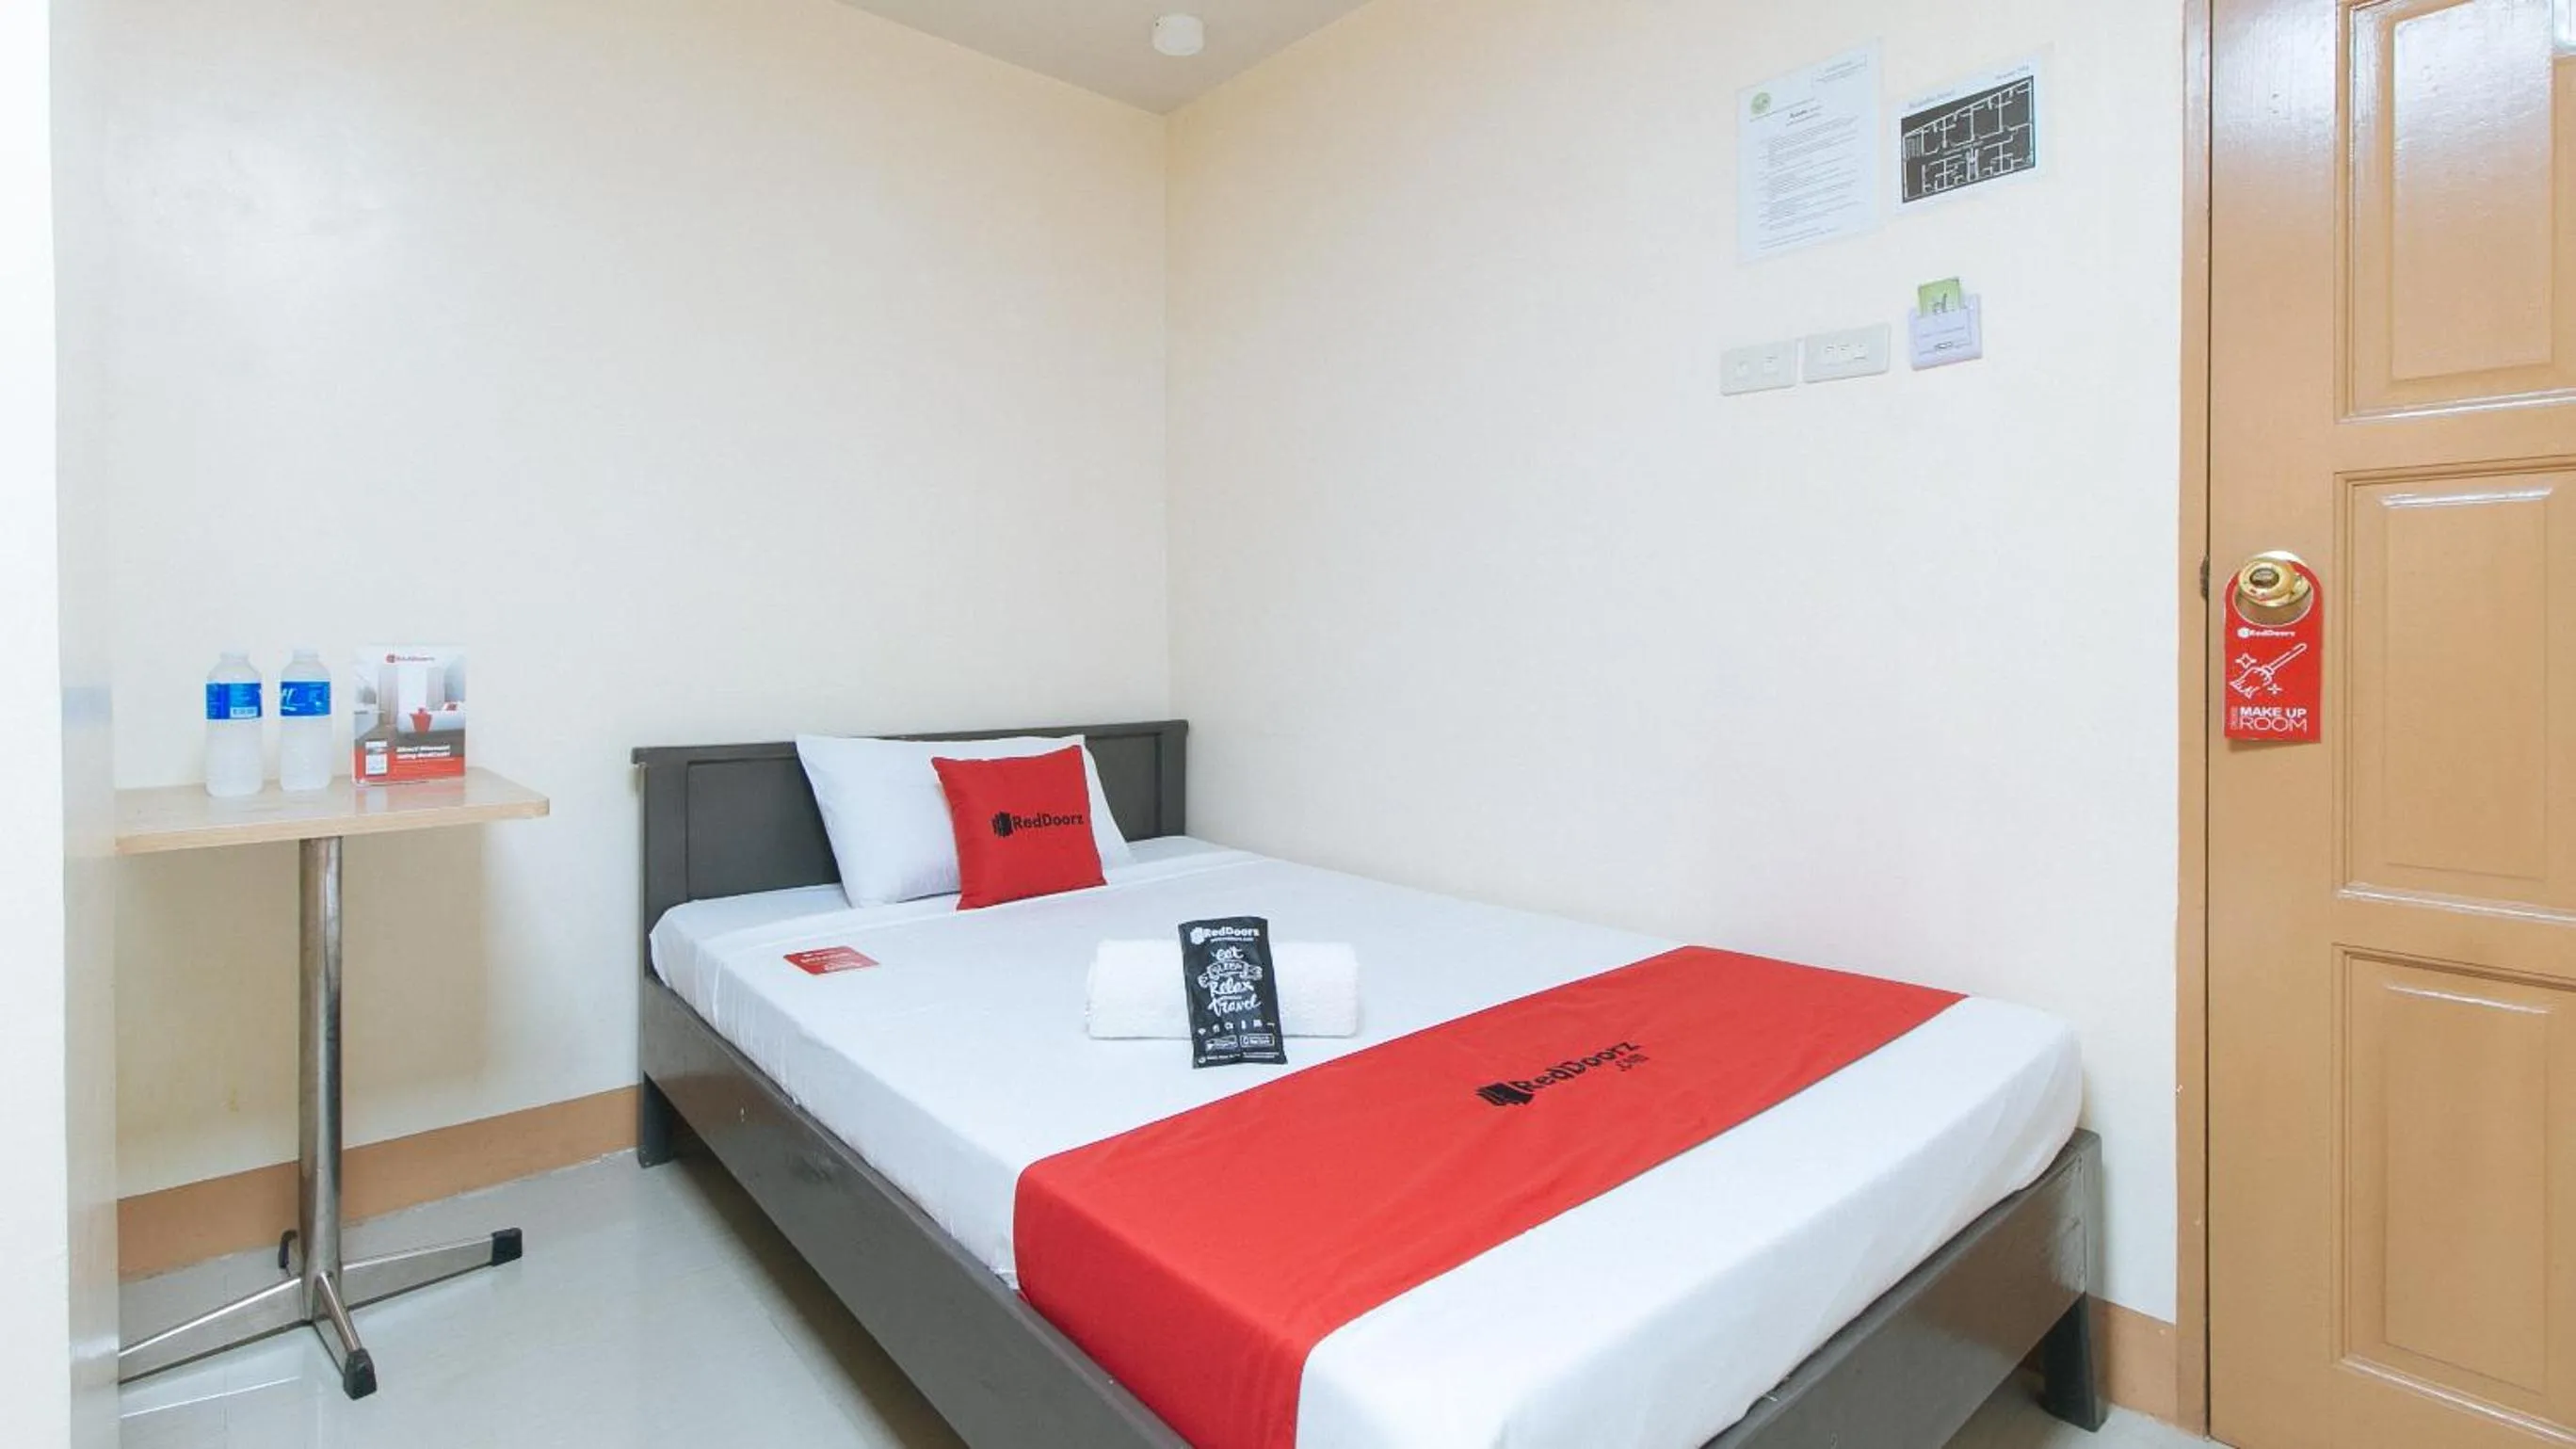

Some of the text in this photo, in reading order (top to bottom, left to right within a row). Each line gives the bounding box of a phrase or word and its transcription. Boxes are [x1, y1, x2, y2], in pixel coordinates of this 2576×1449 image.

[2240, 706, 2307, 718] MAKE UP
[2240, 716, 2308, 733] ROOM
[1012, 813, 1084, 830] RedDoorz
[1209, 976, 1255, 998] Relax
[1508, 1041, 1644, 1093] RedDoorz
